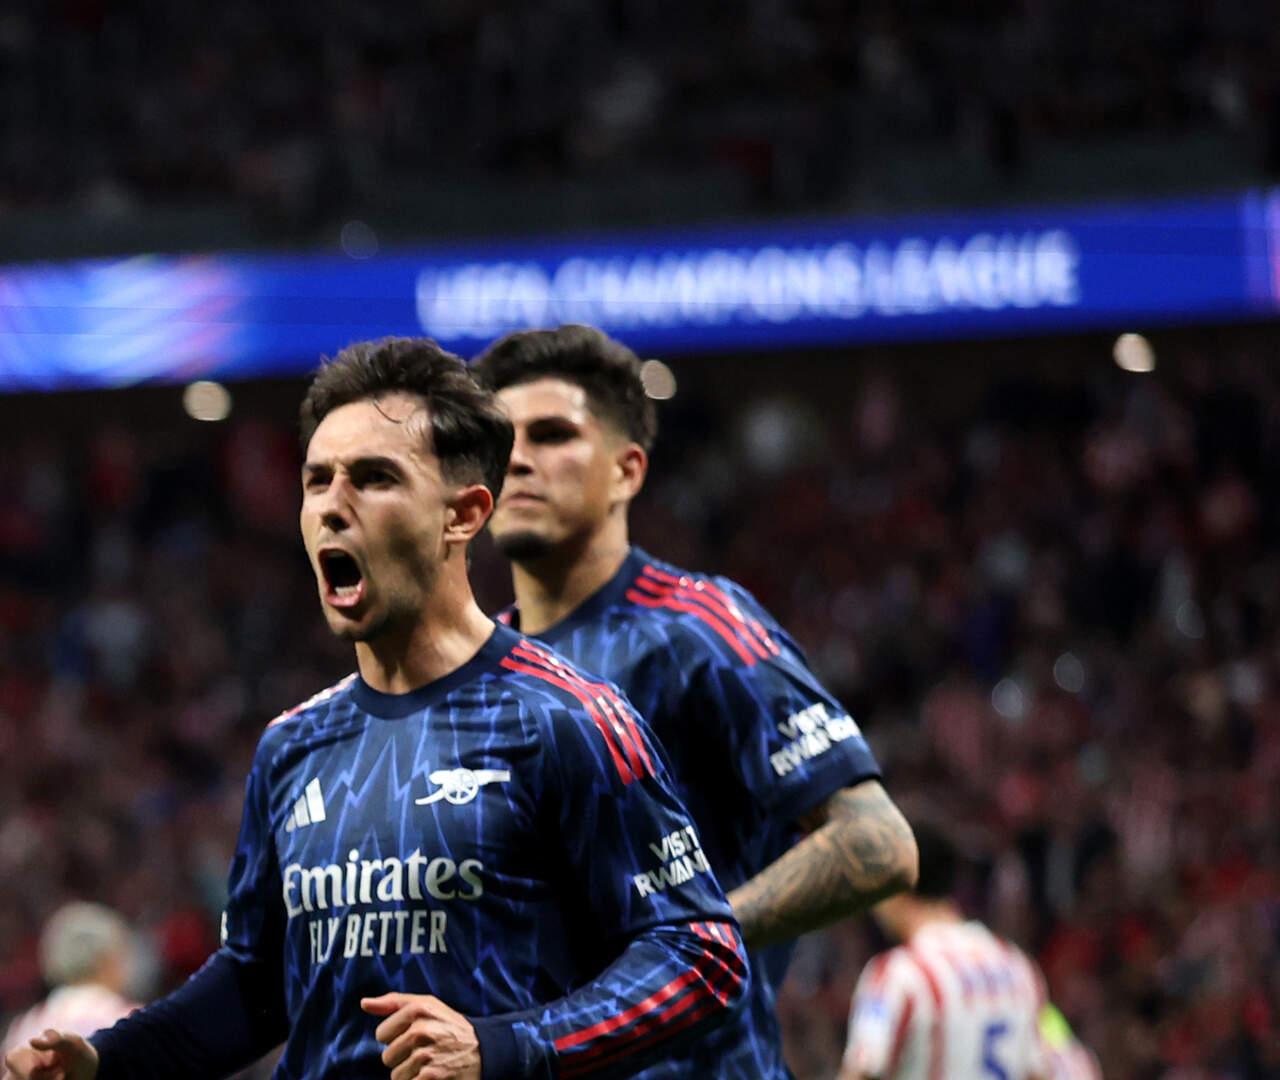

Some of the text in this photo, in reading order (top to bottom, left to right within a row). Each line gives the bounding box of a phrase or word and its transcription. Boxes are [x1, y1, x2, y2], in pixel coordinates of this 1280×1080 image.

[648, 825, 700, 862] VISIT
[283, 848, 485, 918] Emirates
[633, 848, 712, 898] RWAN
[309, 910, 448, 965] FLY BETTER
